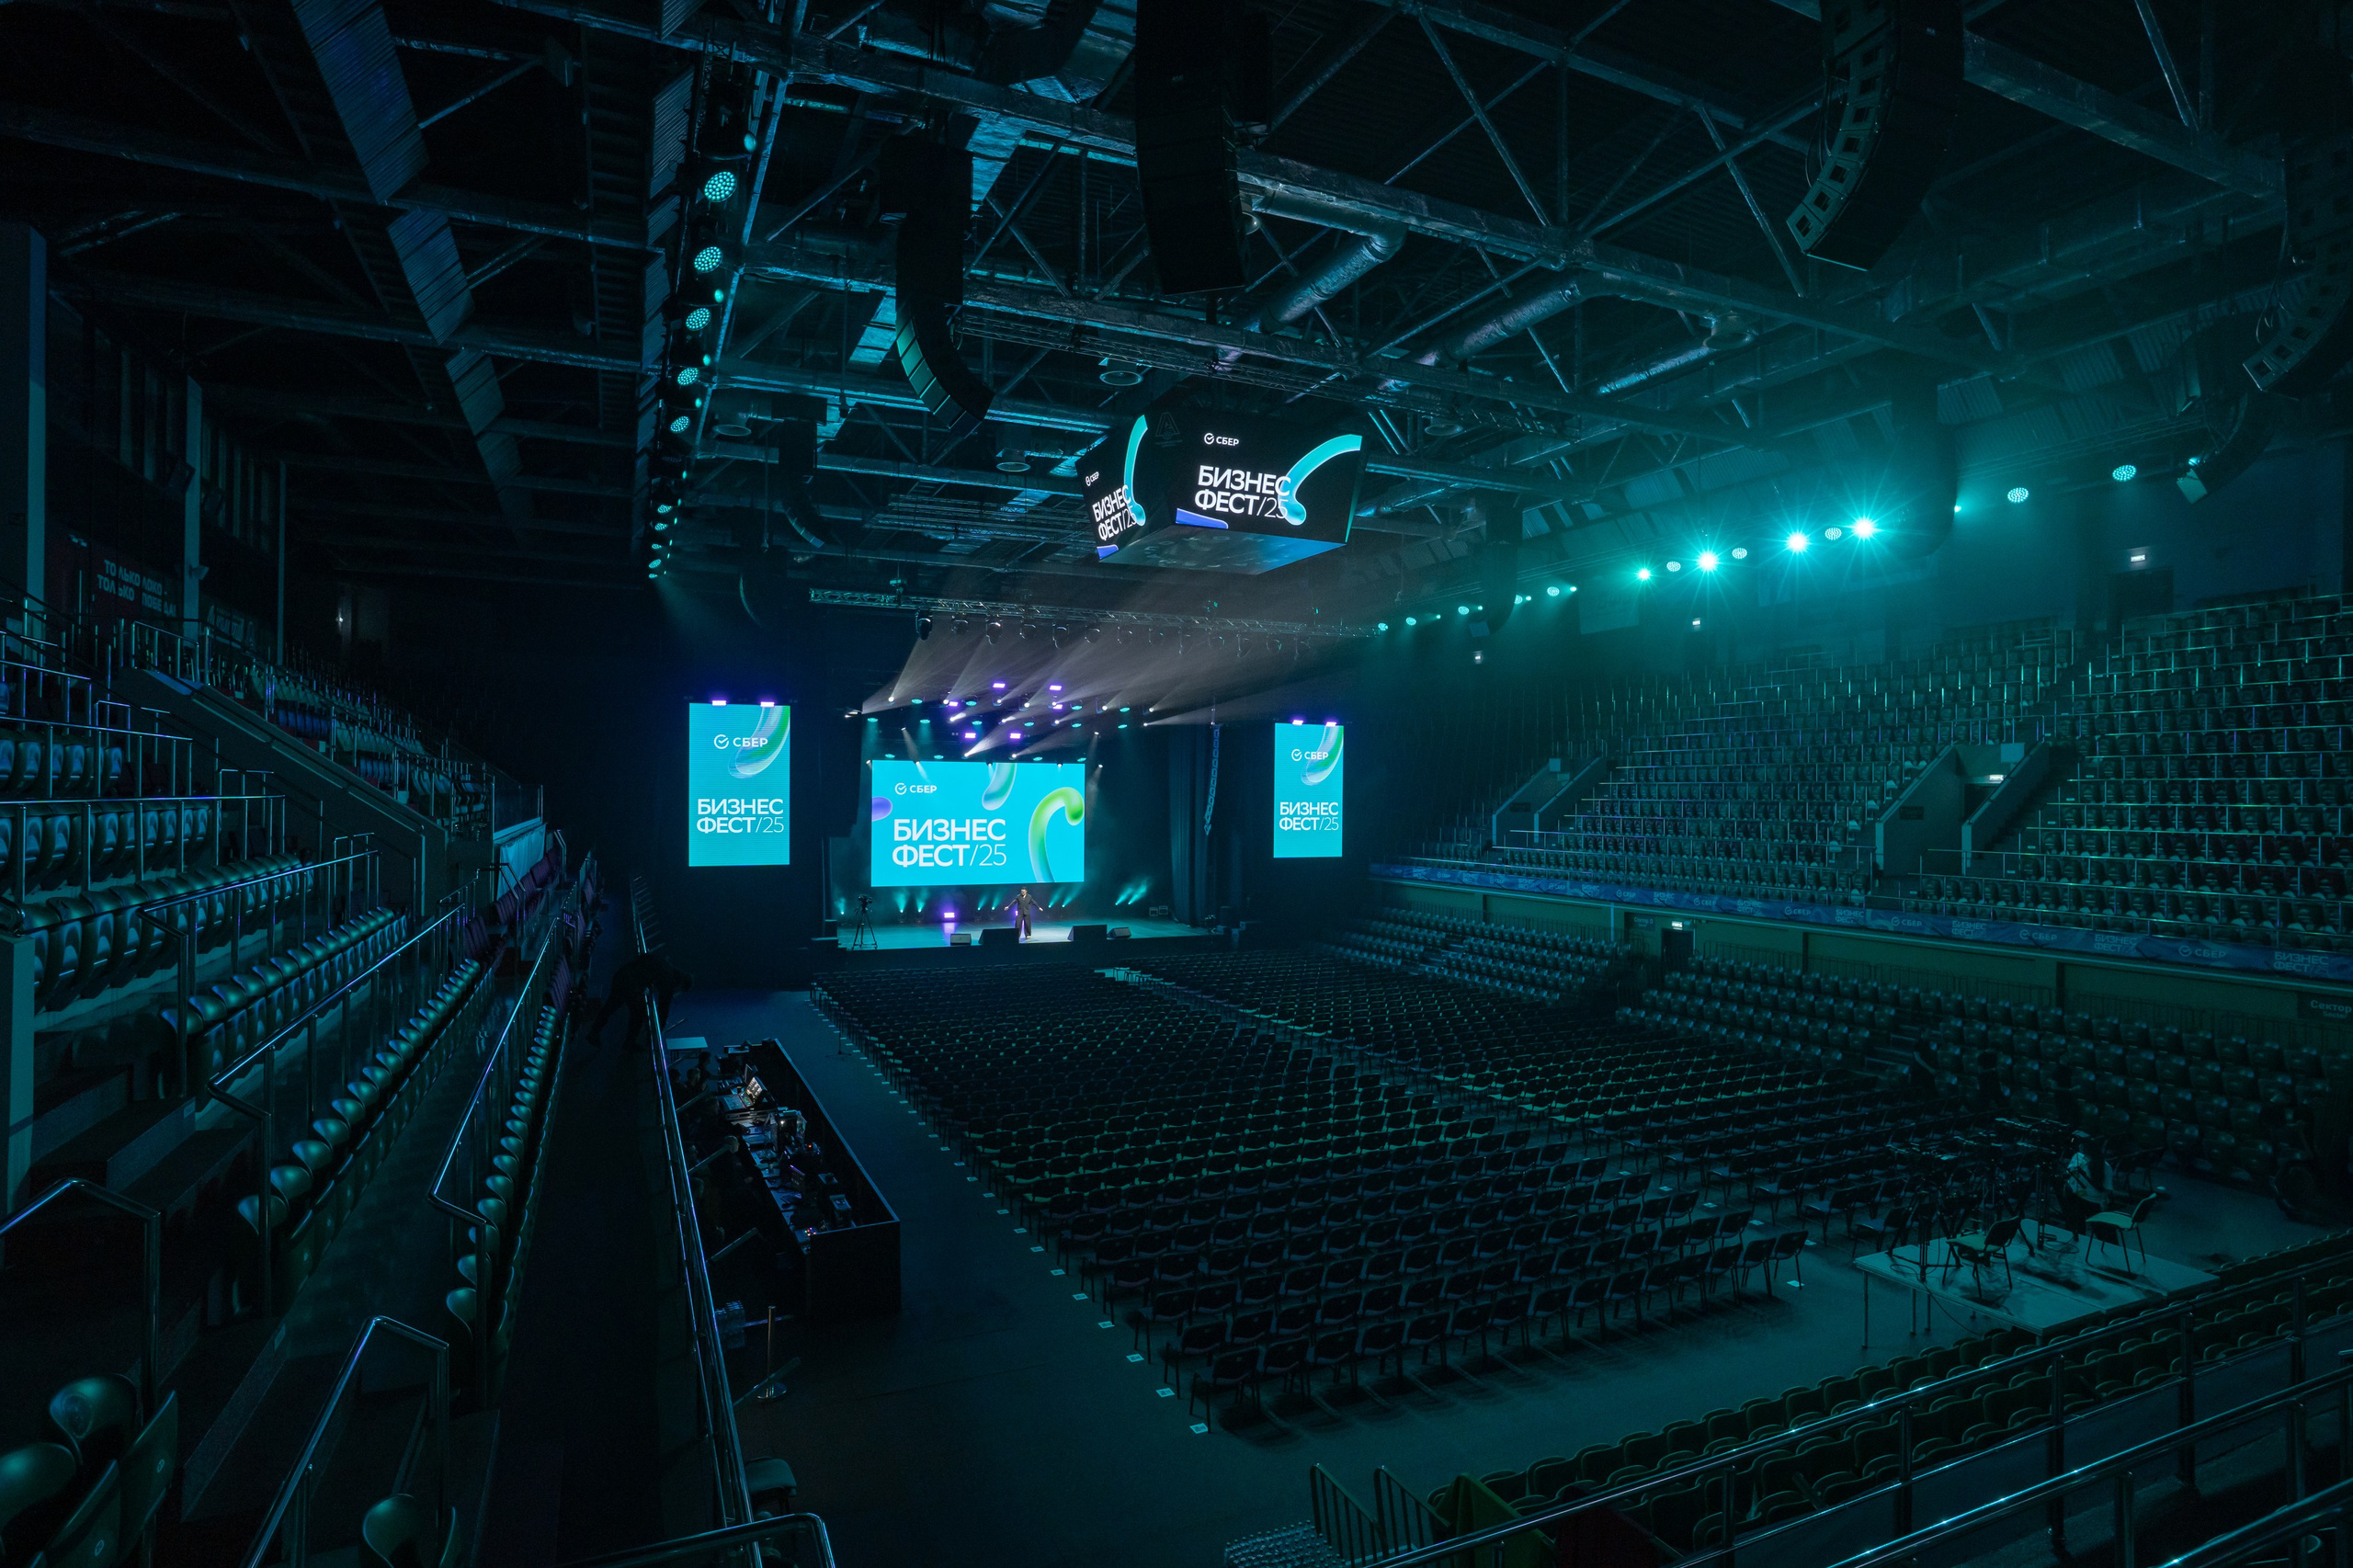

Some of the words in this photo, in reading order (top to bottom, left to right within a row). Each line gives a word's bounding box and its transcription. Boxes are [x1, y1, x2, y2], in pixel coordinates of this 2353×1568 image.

[1216, 437, 1239, 447] СБЕР
[1198, 465, 1291, 496] БИЗНЕС
[1092, 484, 1132, 523] БИЗНЕС
[1195, 489, 1289, 519] ФЕСТ/25
[733, 737, 767, 747] СБЕР
[1304, 751, 1329, 760] СБЕР
[910, 785, 938, 794] СБЕР
[698, 799, 783, 815] БИЗНЕС
[1279, 801, 1338, 816] БИЗНЕС
[697, 816, 784, 834] ФЕСТ/25
[893, 818, 1006, 841] БИЗНЕС
[1279, 816, 1339, 831] ФЕСТ/25
[892, 844, 1006, 868] ФЕСТ/25
[2031, 932, 2058, 941] СБЕР
[2094, 934, 2138, 945] БИЗНЕС
[2194, 949, 2226, 959] СБЕР
[2274, 951, 2329, 966] БИЗНЕС
[2310, 999, 2352, 1014] Сектор
